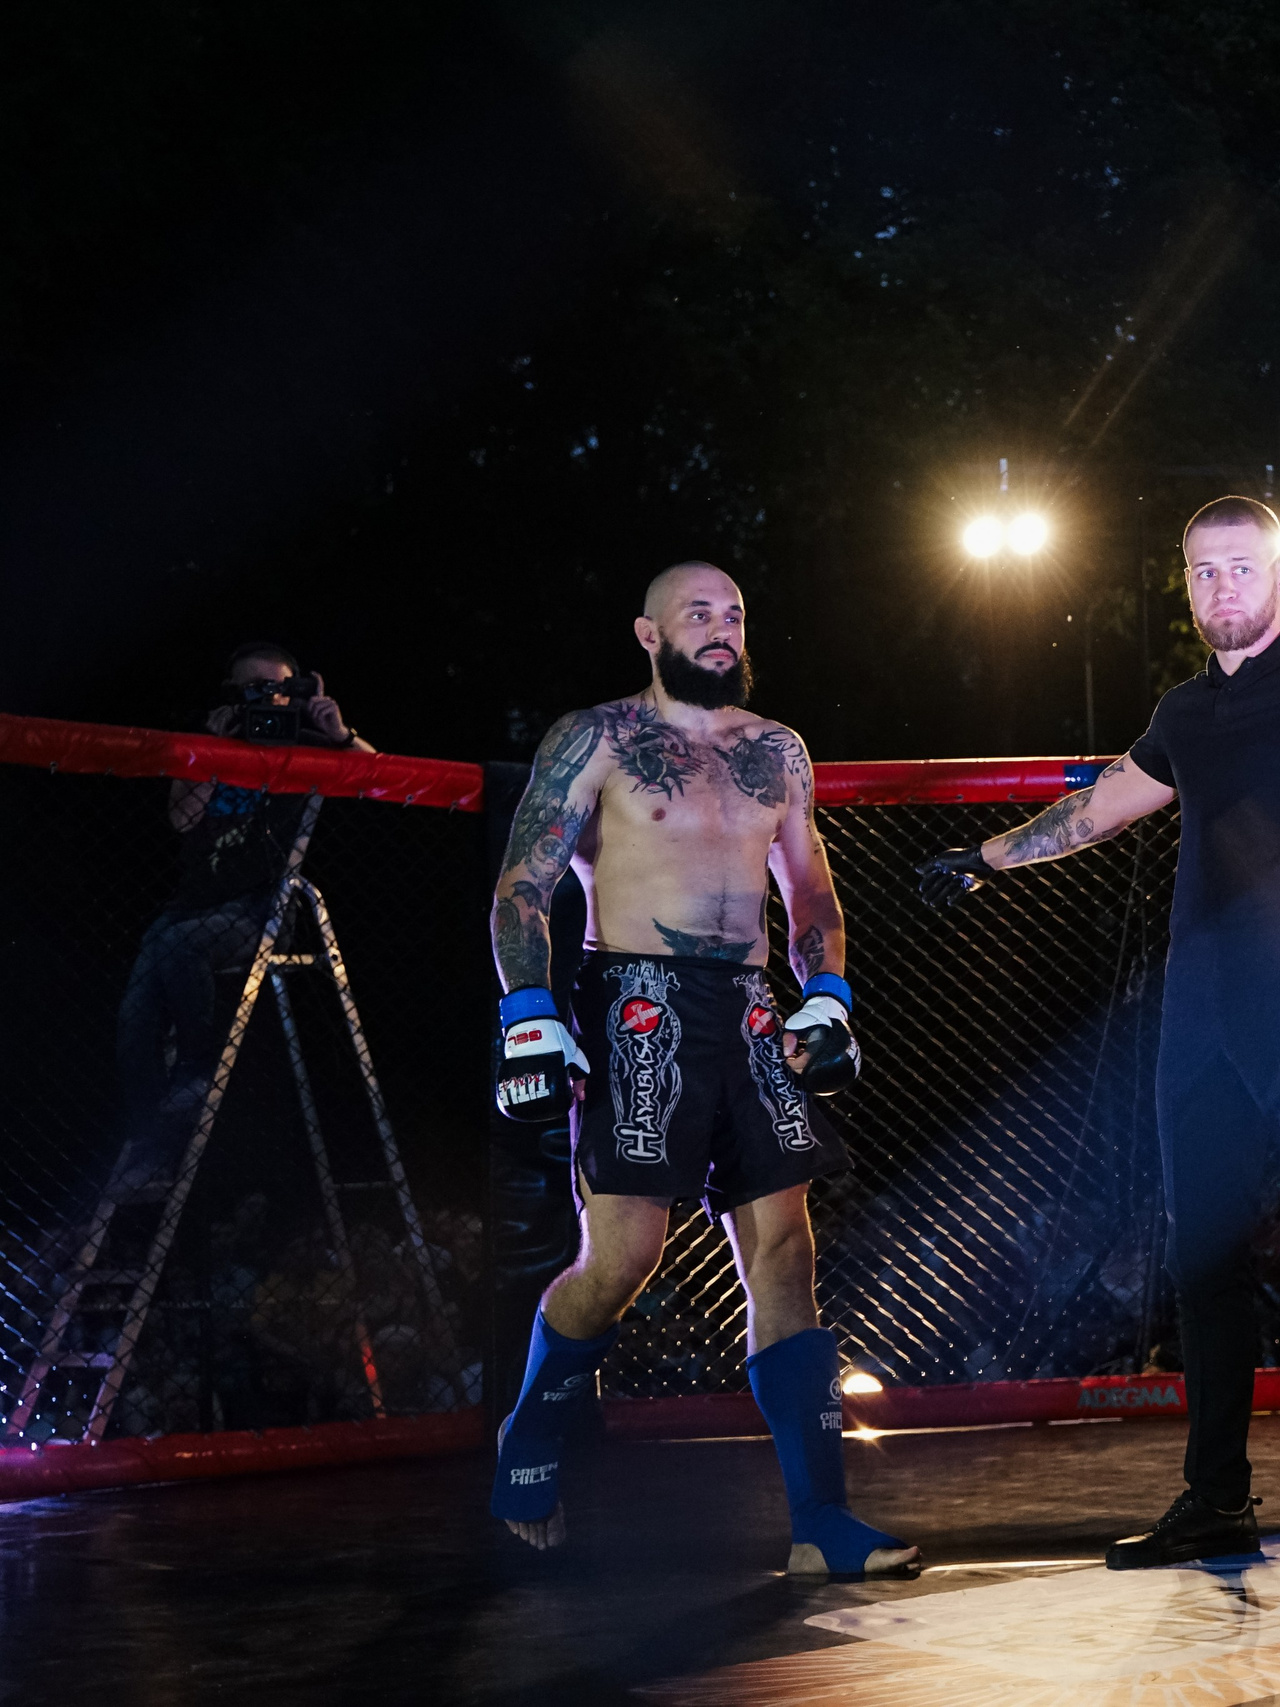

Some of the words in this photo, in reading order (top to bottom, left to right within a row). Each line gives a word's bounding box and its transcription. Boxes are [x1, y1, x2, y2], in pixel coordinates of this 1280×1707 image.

[507, 1030, 542, 1046] GEL
[499, 1073, 550, 1107] TITLE
[619, 1030, 660, 1157] HAYABUSA
[1077, 1385, 1181, 1409] ADEGMA
[510, 1471, 552, 1485] HILL
